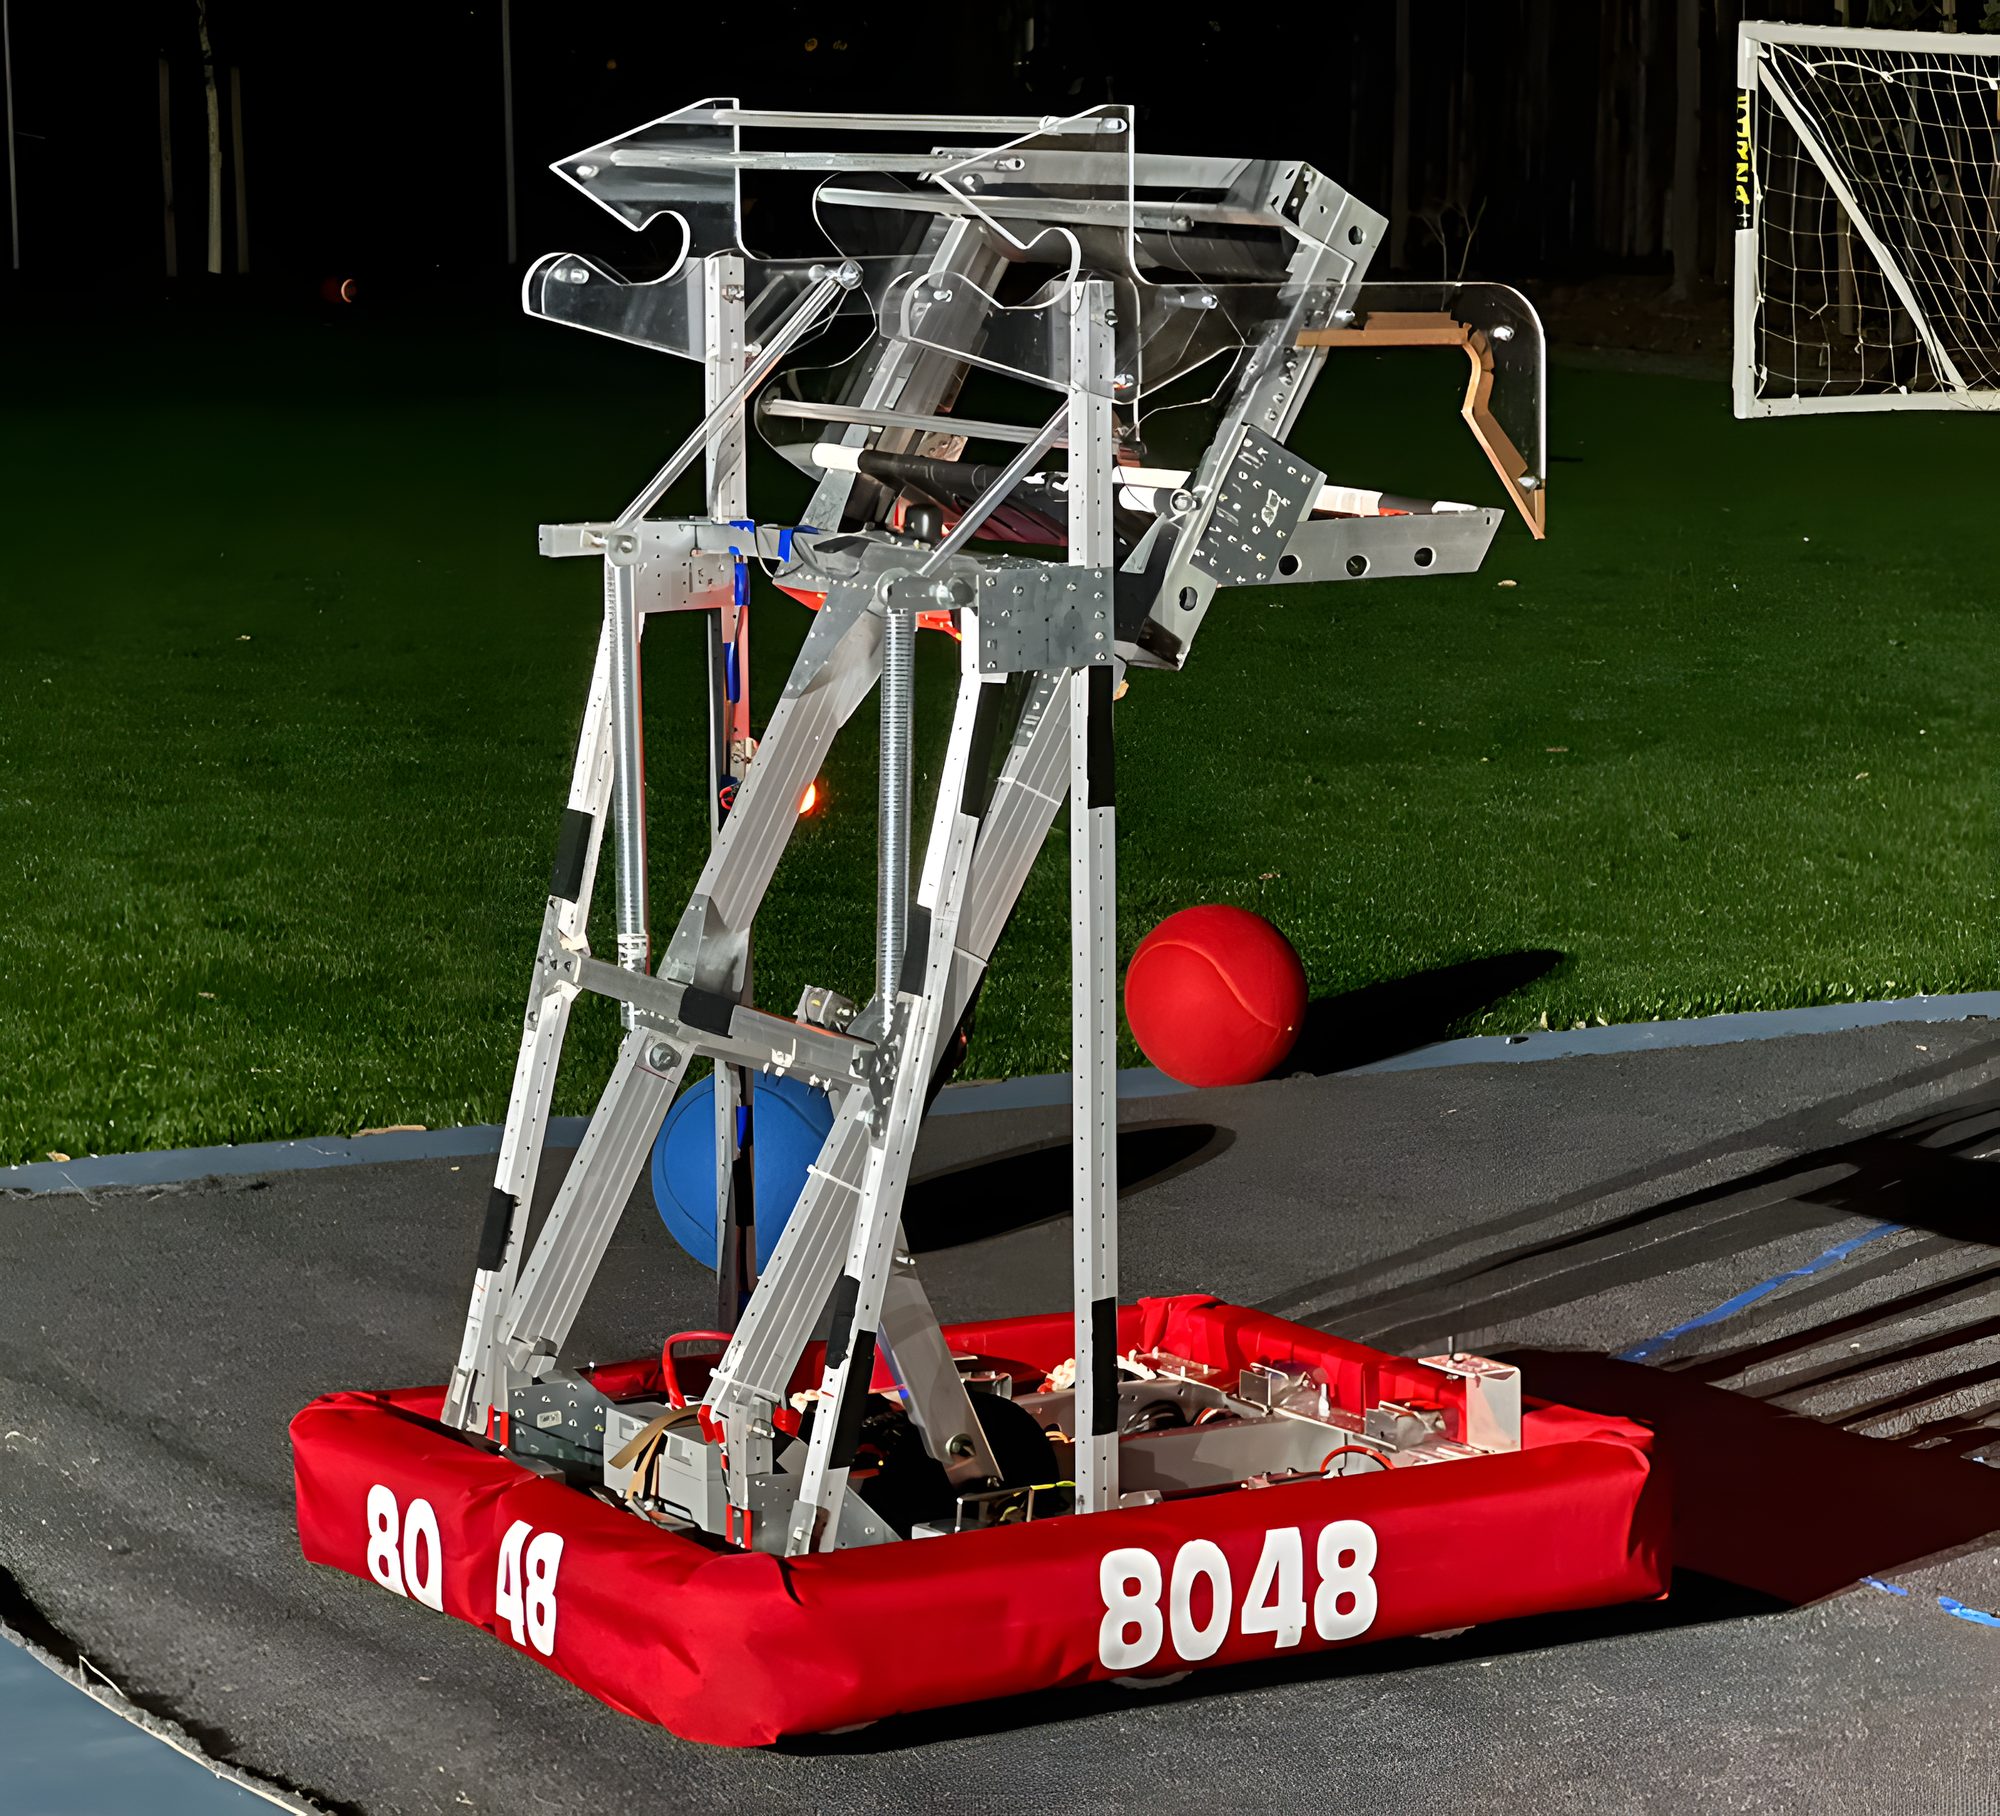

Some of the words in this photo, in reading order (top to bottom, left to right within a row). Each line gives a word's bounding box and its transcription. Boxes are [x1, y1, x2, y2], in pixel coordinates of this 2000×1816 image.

[366, 1483, 444, 1613] 80
[495, 1519, 564, 1657] 48
[1098, 1519, 1378, 1670] 8048
